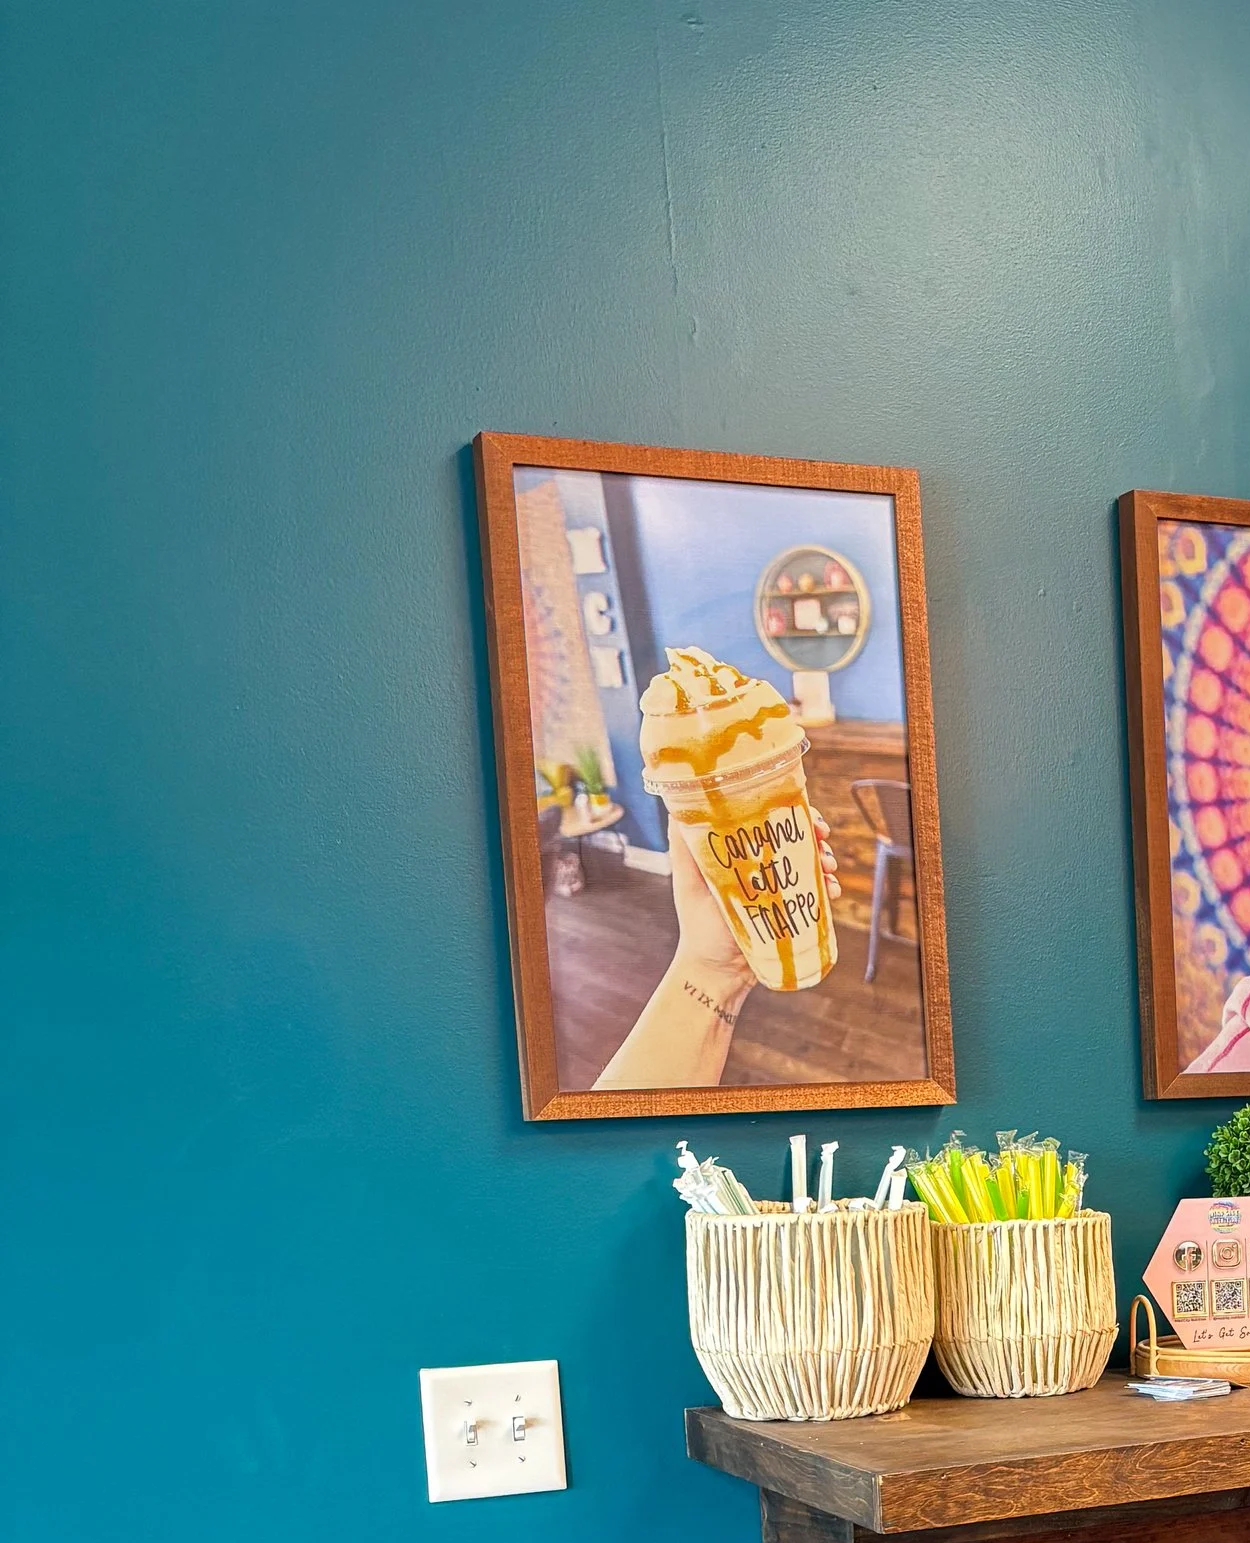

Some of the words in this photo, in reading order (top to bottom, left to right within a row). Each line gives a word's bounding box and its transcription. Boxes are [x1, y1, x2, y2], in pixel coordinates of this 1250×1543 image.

[708, 806, 805, 869] Caramel
[735, 856, 799, 902] Latte
[1193, 1329, 1213, 1343] Let's
[1218, 1326, 1235, 1339] Get
